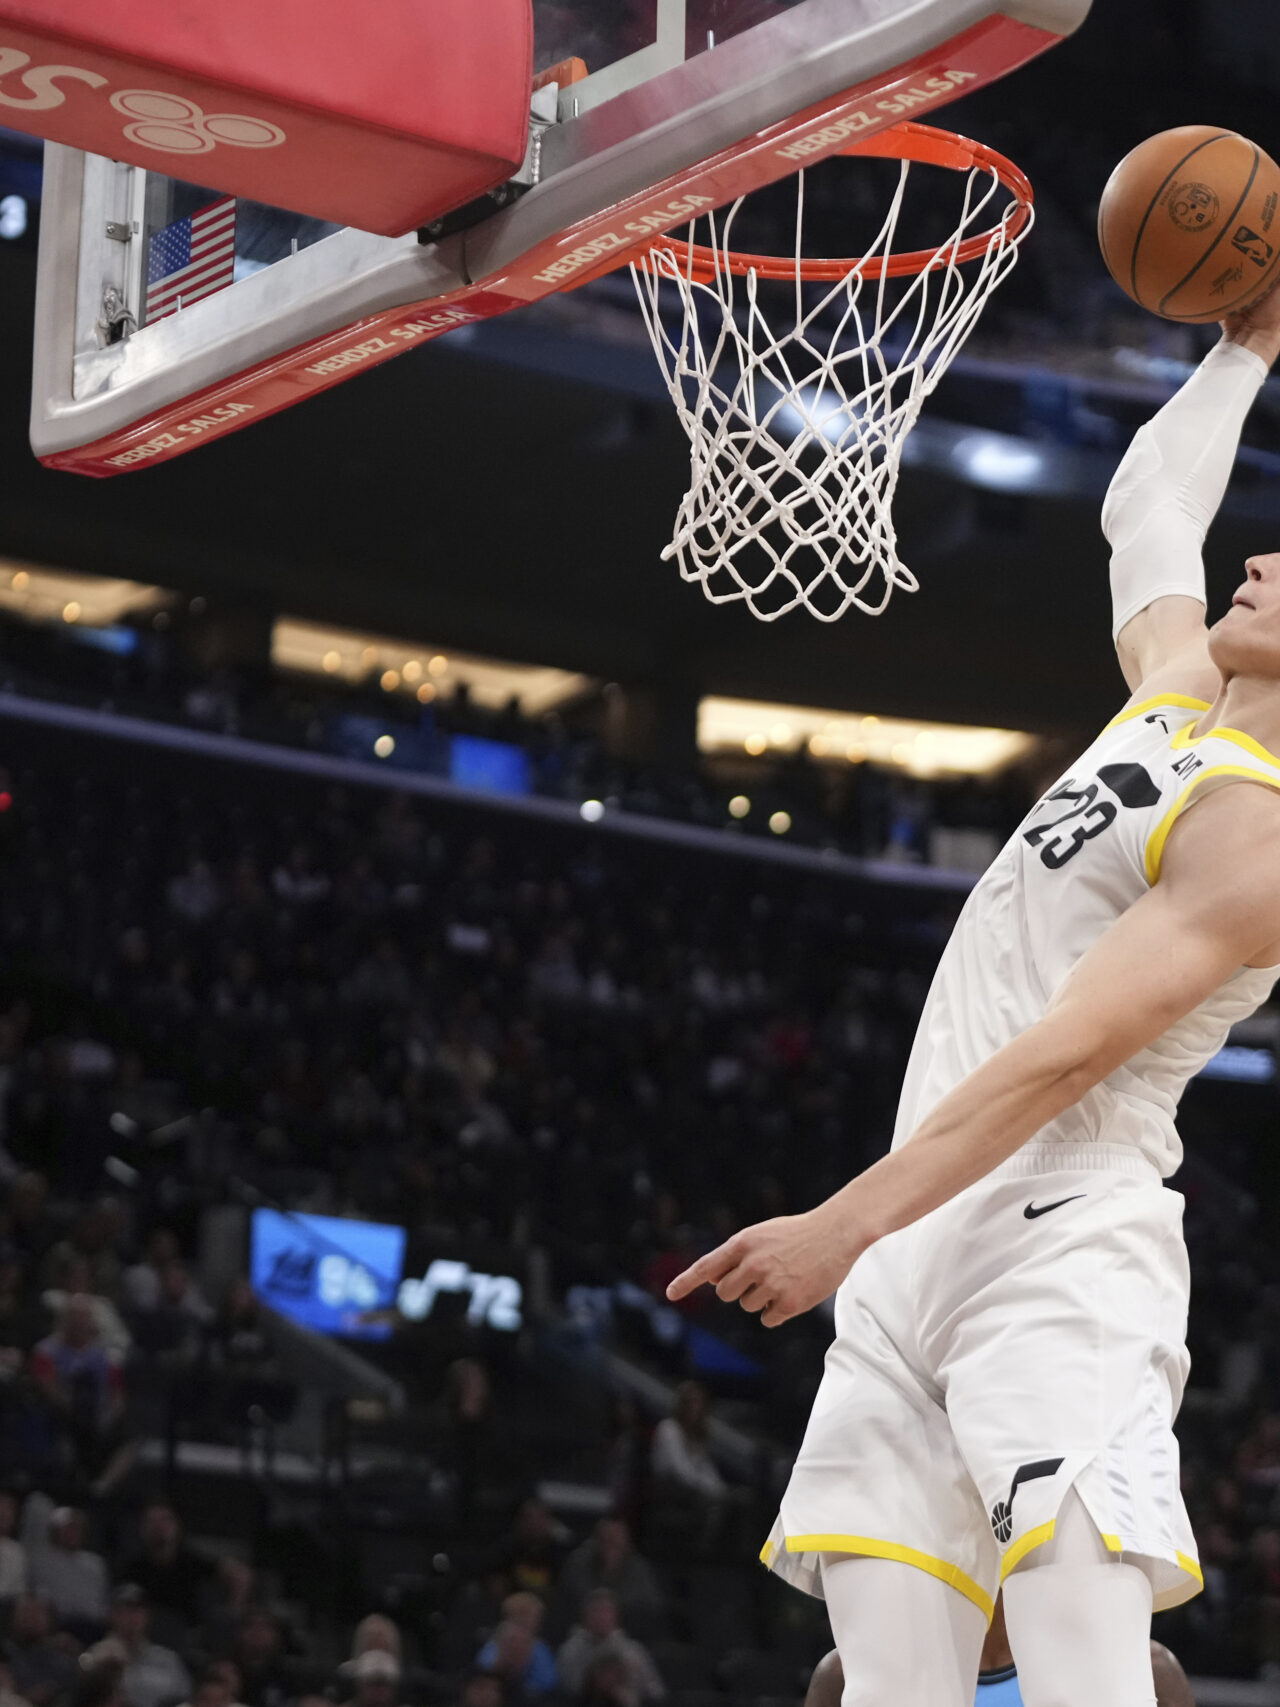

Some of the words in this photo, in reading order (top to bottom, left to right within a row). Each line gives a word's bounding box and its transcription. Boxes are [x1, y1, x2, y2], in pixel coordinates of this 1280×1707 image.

[775, 111, 882, 159] HERDEZ
[876, 69, 977, 114] SALSA
[532, 232, 631, 283] HERDEZ
[624, 194, 714, 234] SALSA
[304, 337, 396, 375] HERDEZ
[390, 311, 476, 339] SALSA
[104, 432, 186, 467] HERDEZ
[177, 402, 255, 434] SALSA
[1022, 783, 1117, 870] 23
